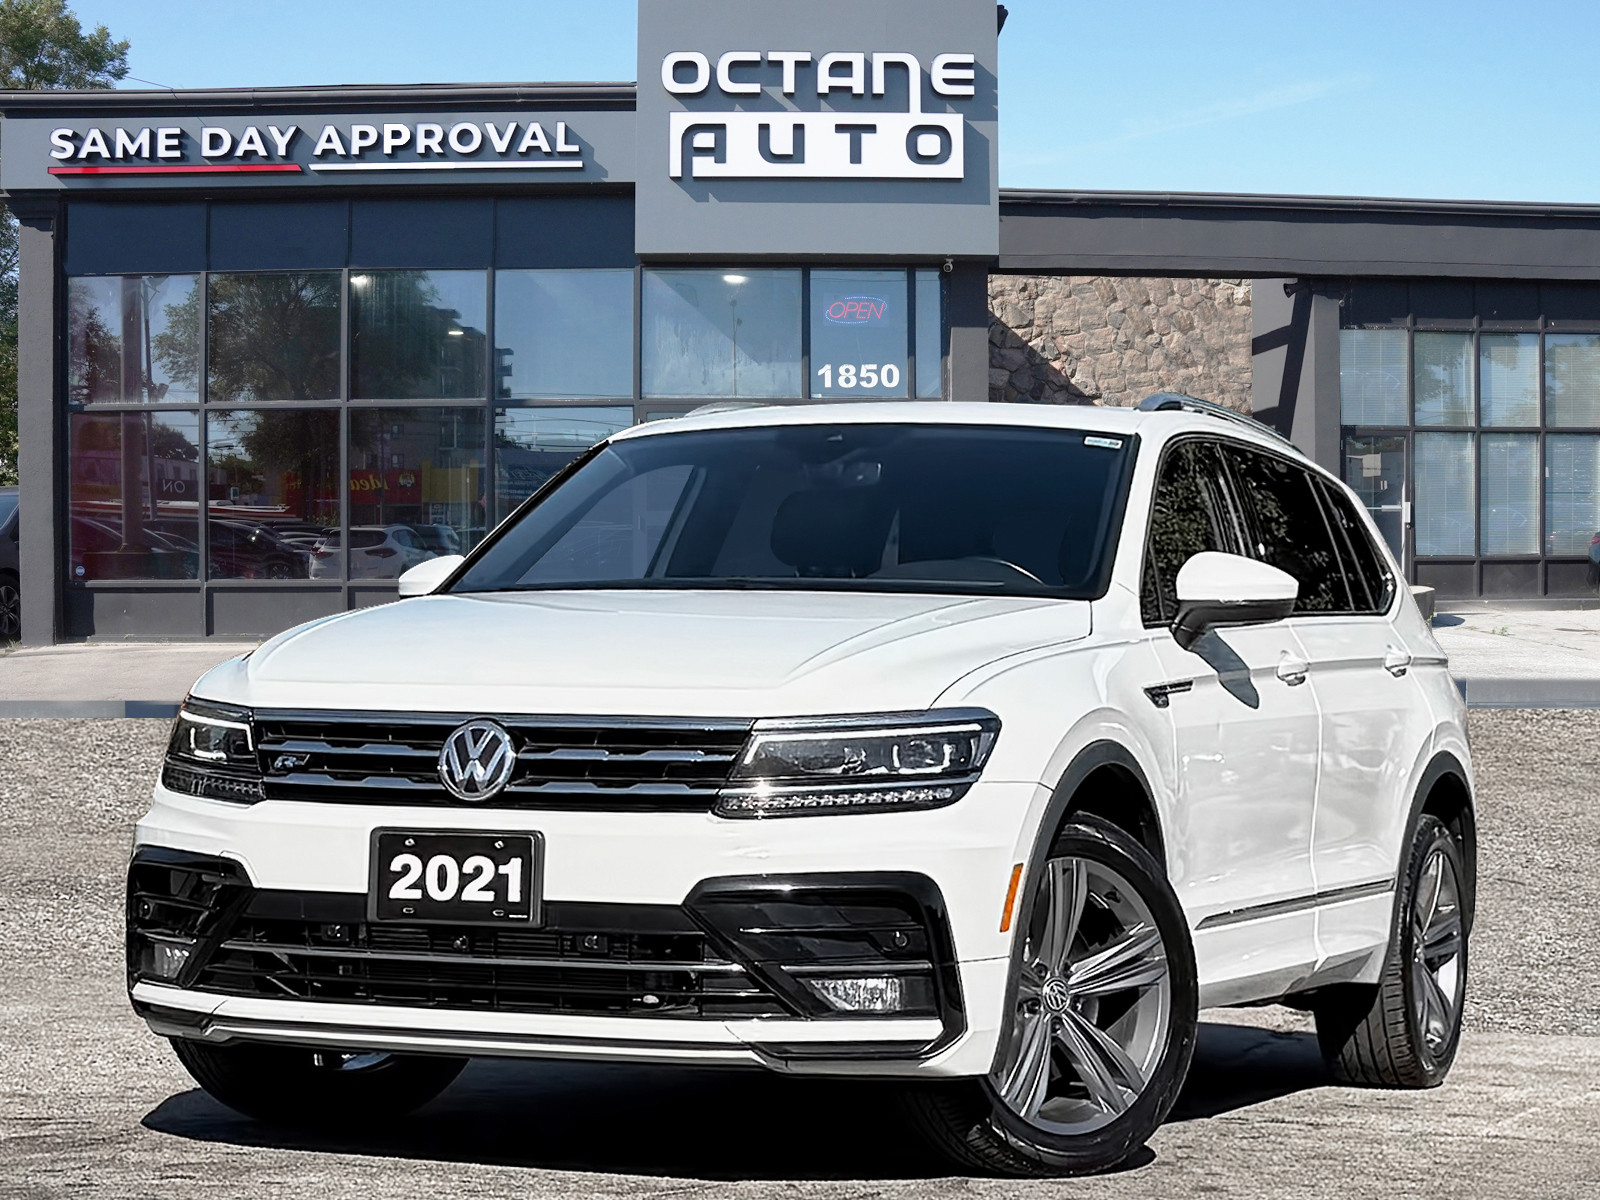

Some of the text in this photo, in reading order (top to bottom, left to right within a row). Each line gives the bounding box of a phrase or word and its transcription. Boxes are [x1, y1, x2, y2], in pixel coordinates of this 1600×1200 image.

[661, 51, 975, 97] OCTANE
[49, 122, 580, 160] SAME DAY APPROVAL
[680, 122, 953, 177] AUTO
[829, 302, 885, 319] OPEN
[817, 364, 900, 388] 1850
[388, 853, 522, 903] 2021
